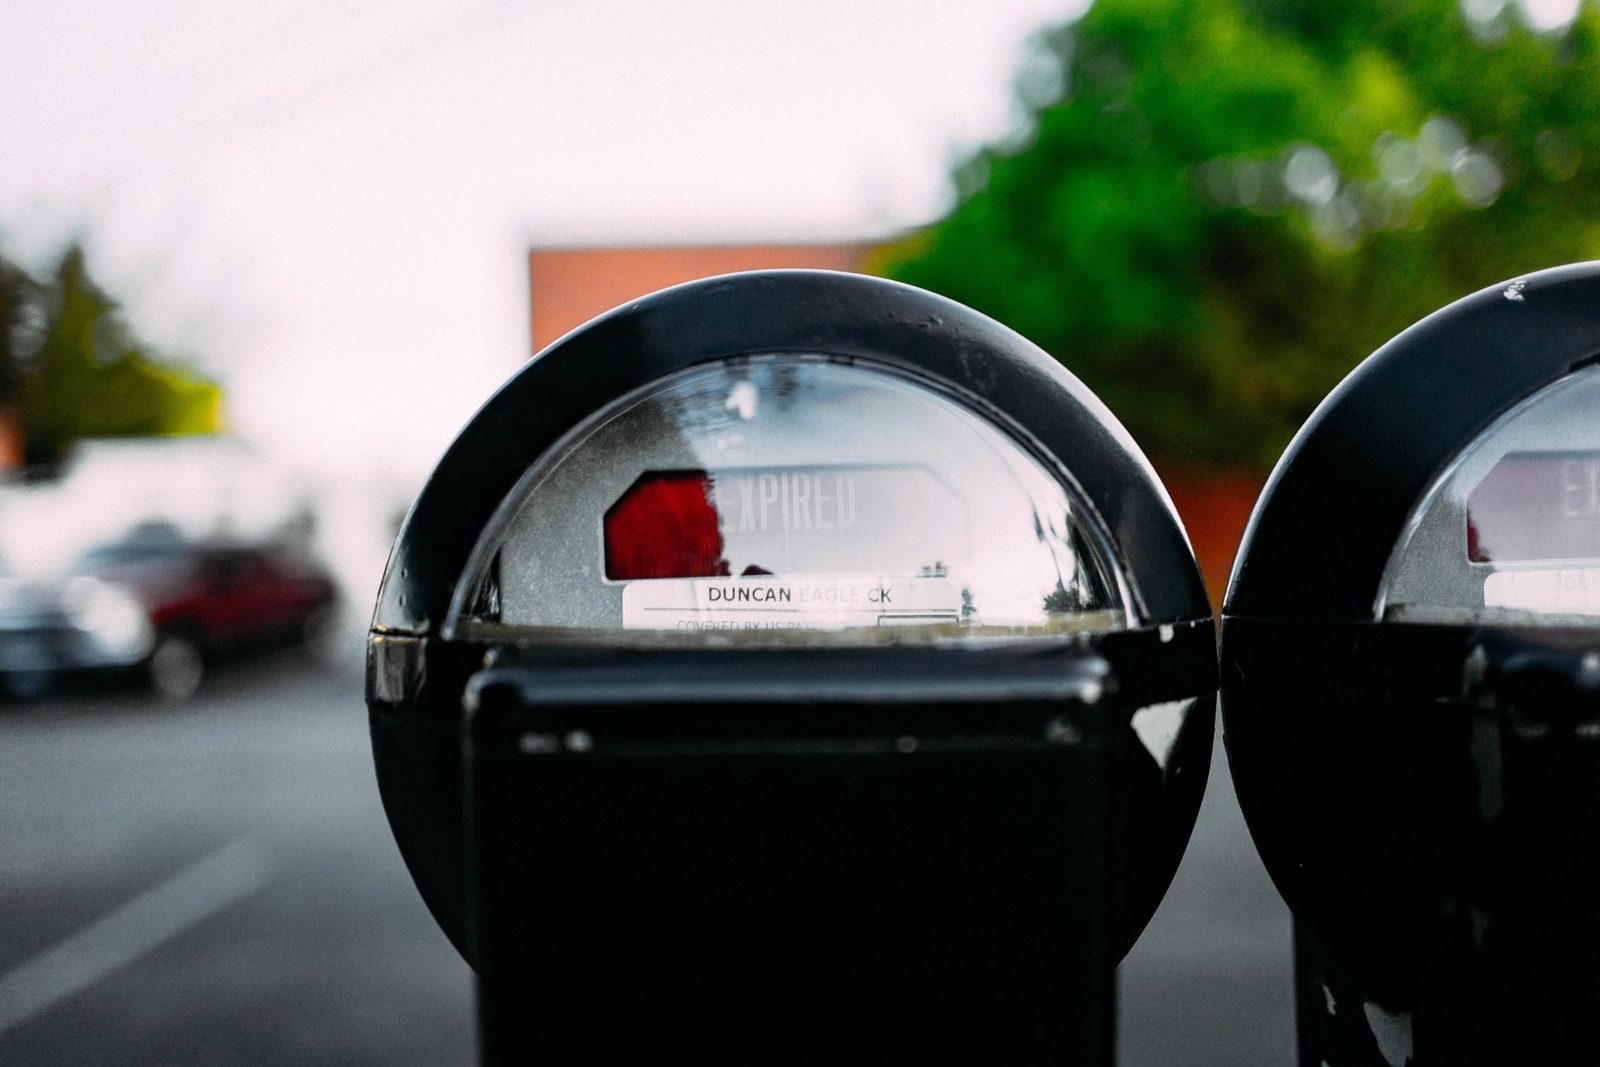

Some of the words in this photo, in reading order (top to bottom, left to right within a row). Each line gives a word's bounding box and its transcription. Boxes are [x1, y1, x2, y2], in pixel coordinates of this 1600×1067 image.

[716, 472, 856, 532] EXPIRED
[708, 586, 792, 603] DUNCAN
[799, 587, 861, 604] EAGLE
[867, 587, 893, 604] CK
[677, 620, 740, 631] COVERED
[744, 621, 761, 631] BY
[765, 621, 782, 631] US
